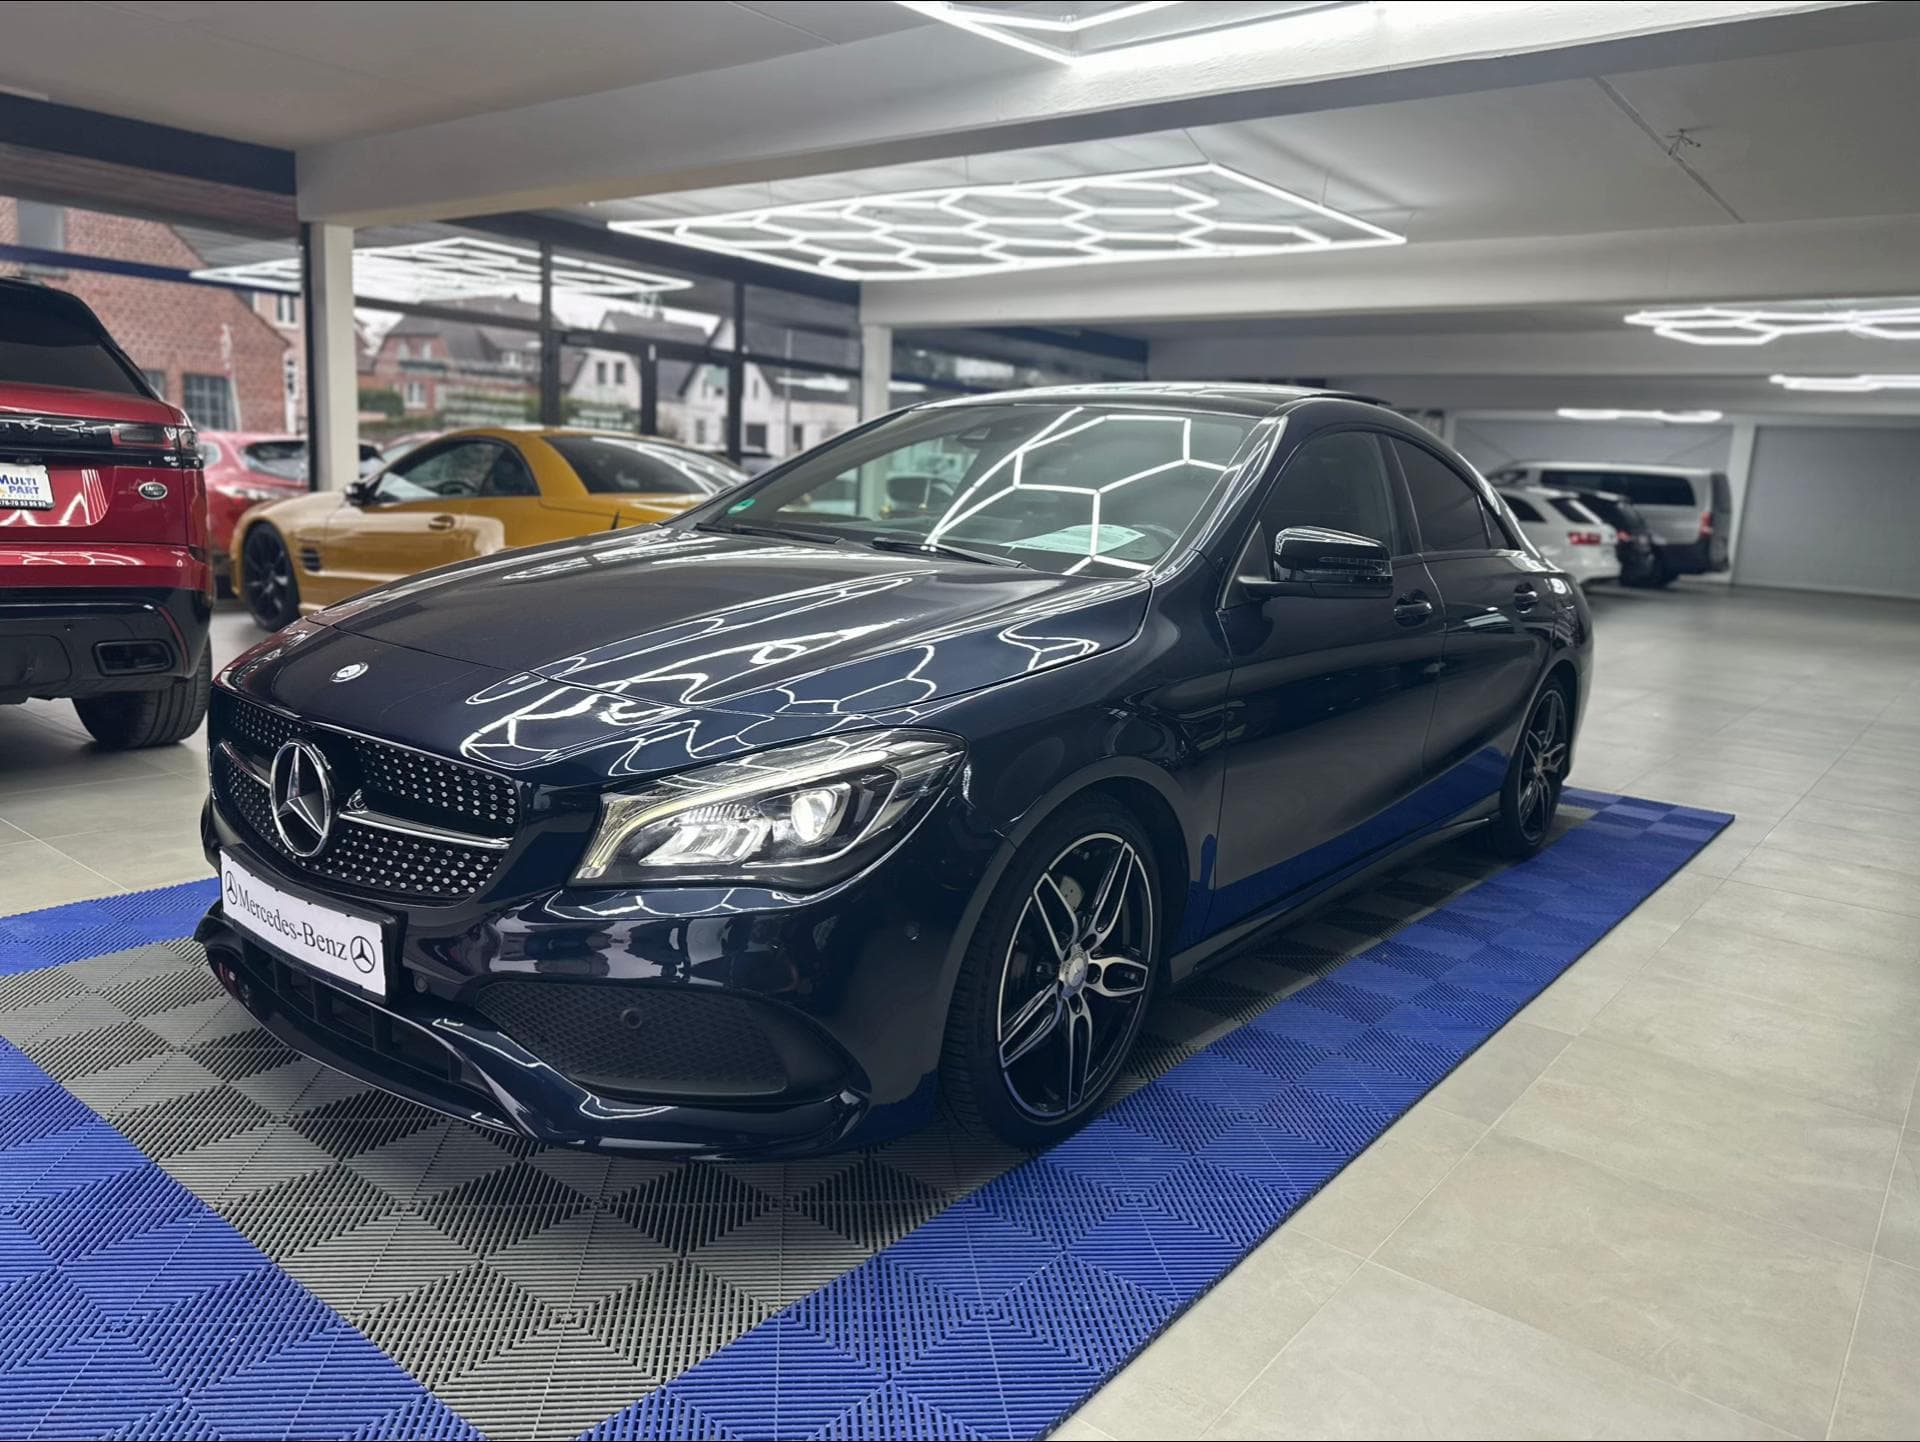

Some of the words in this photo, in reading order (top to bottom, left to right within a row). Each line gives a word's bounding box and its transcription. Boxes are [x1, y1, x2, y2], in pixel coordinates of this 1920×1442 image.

[0, 475, 37, 485] MULTI
[9, 485, 39, 494] PART
[238, 884, 348, 960] Mercedes-Benz
